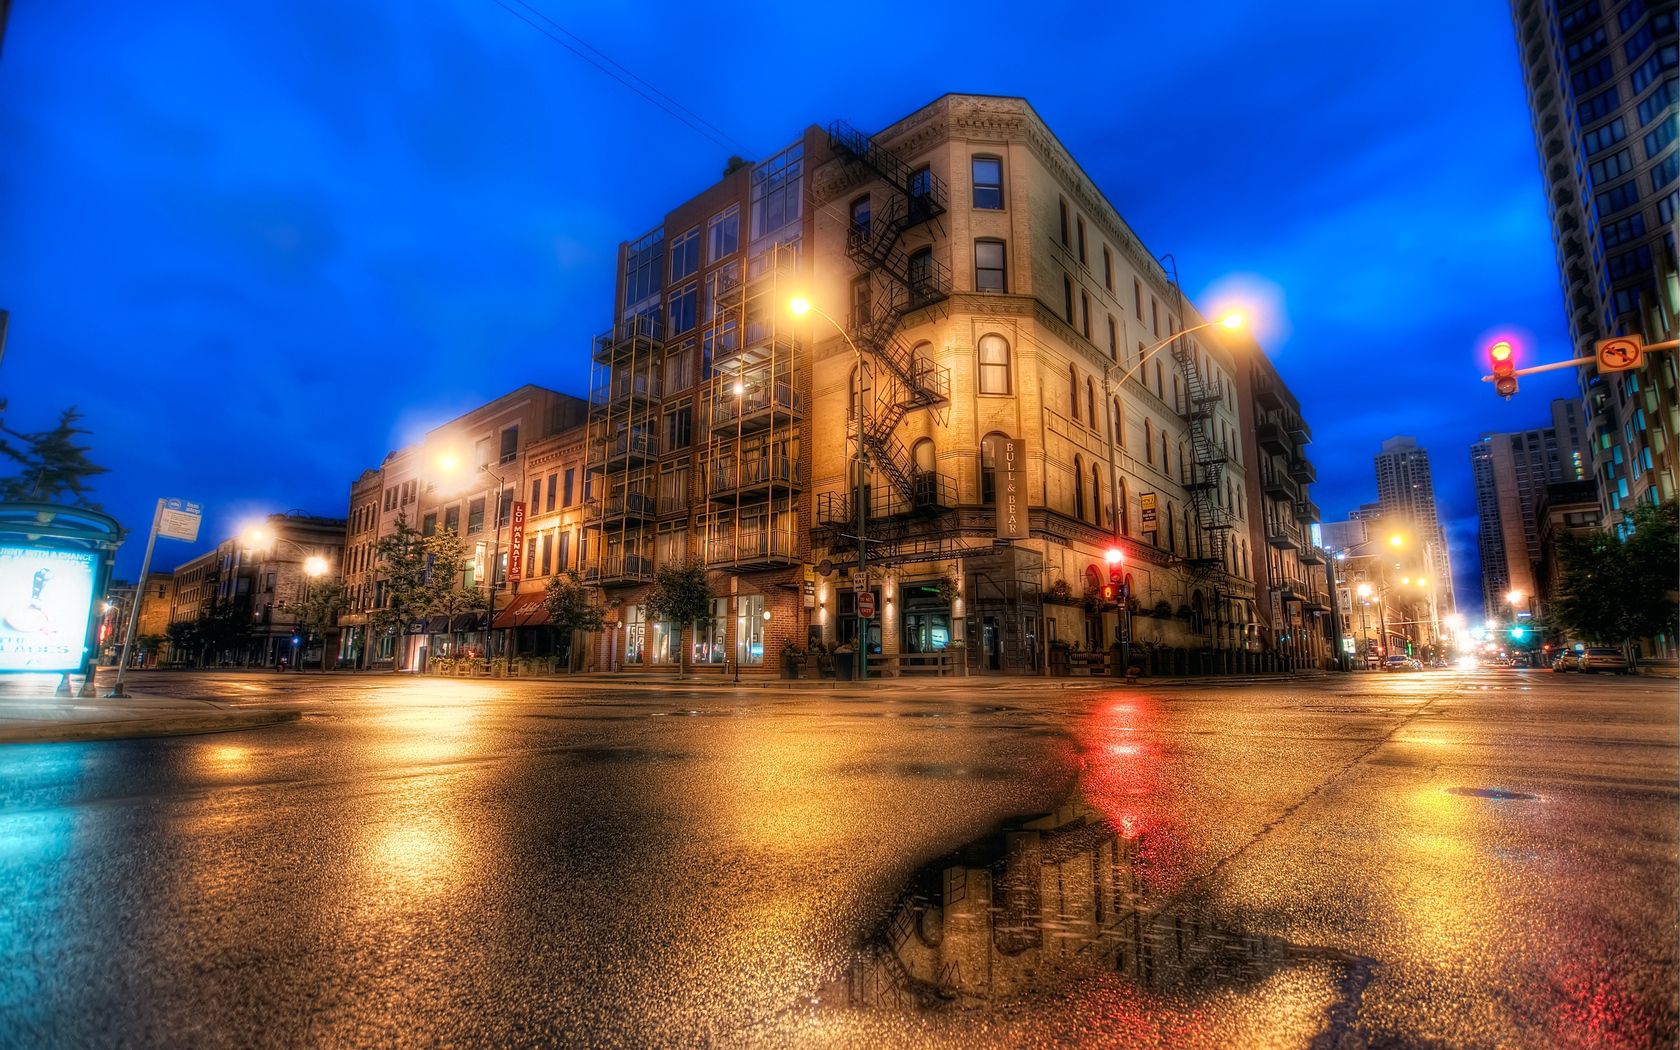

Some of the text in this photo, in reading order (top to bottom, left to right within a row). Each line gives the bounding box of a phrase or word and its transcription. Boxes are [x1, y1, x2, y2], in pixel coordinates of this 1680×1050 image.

[1006, 442, 1017, 533] BULL & BEAR
[515, 505, 523, 523] LOU
[59, 551, 94, 561] CHANCE
